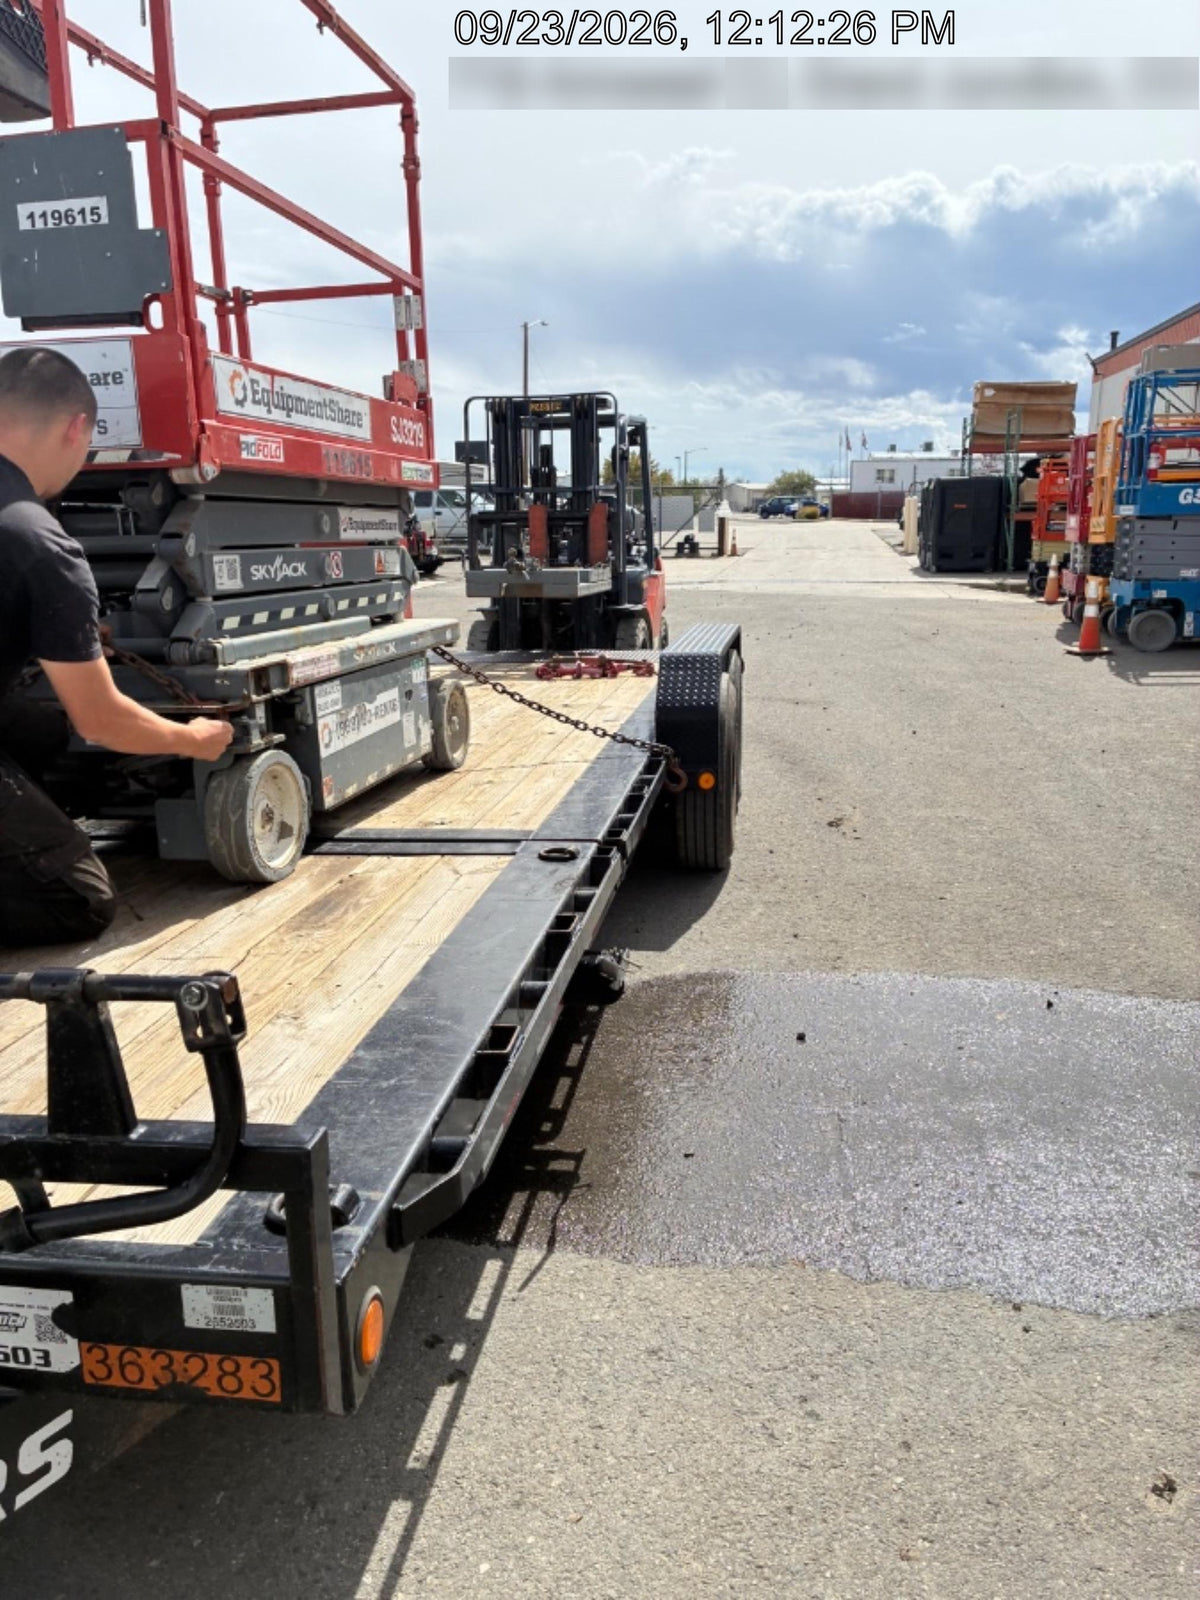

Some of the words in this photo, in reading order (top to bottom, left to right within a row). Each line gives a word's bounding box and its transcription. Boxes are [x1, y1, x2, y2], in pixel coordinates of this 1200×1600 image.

[26, 206, 102, 229] 119615
[250, 378, 364, 429] EquipmentShare
[390, 415, 424, 448] SJ3219
[250, 554, 308, 582] SKYJACK
[86, 1343, 277, 1398] 363283
